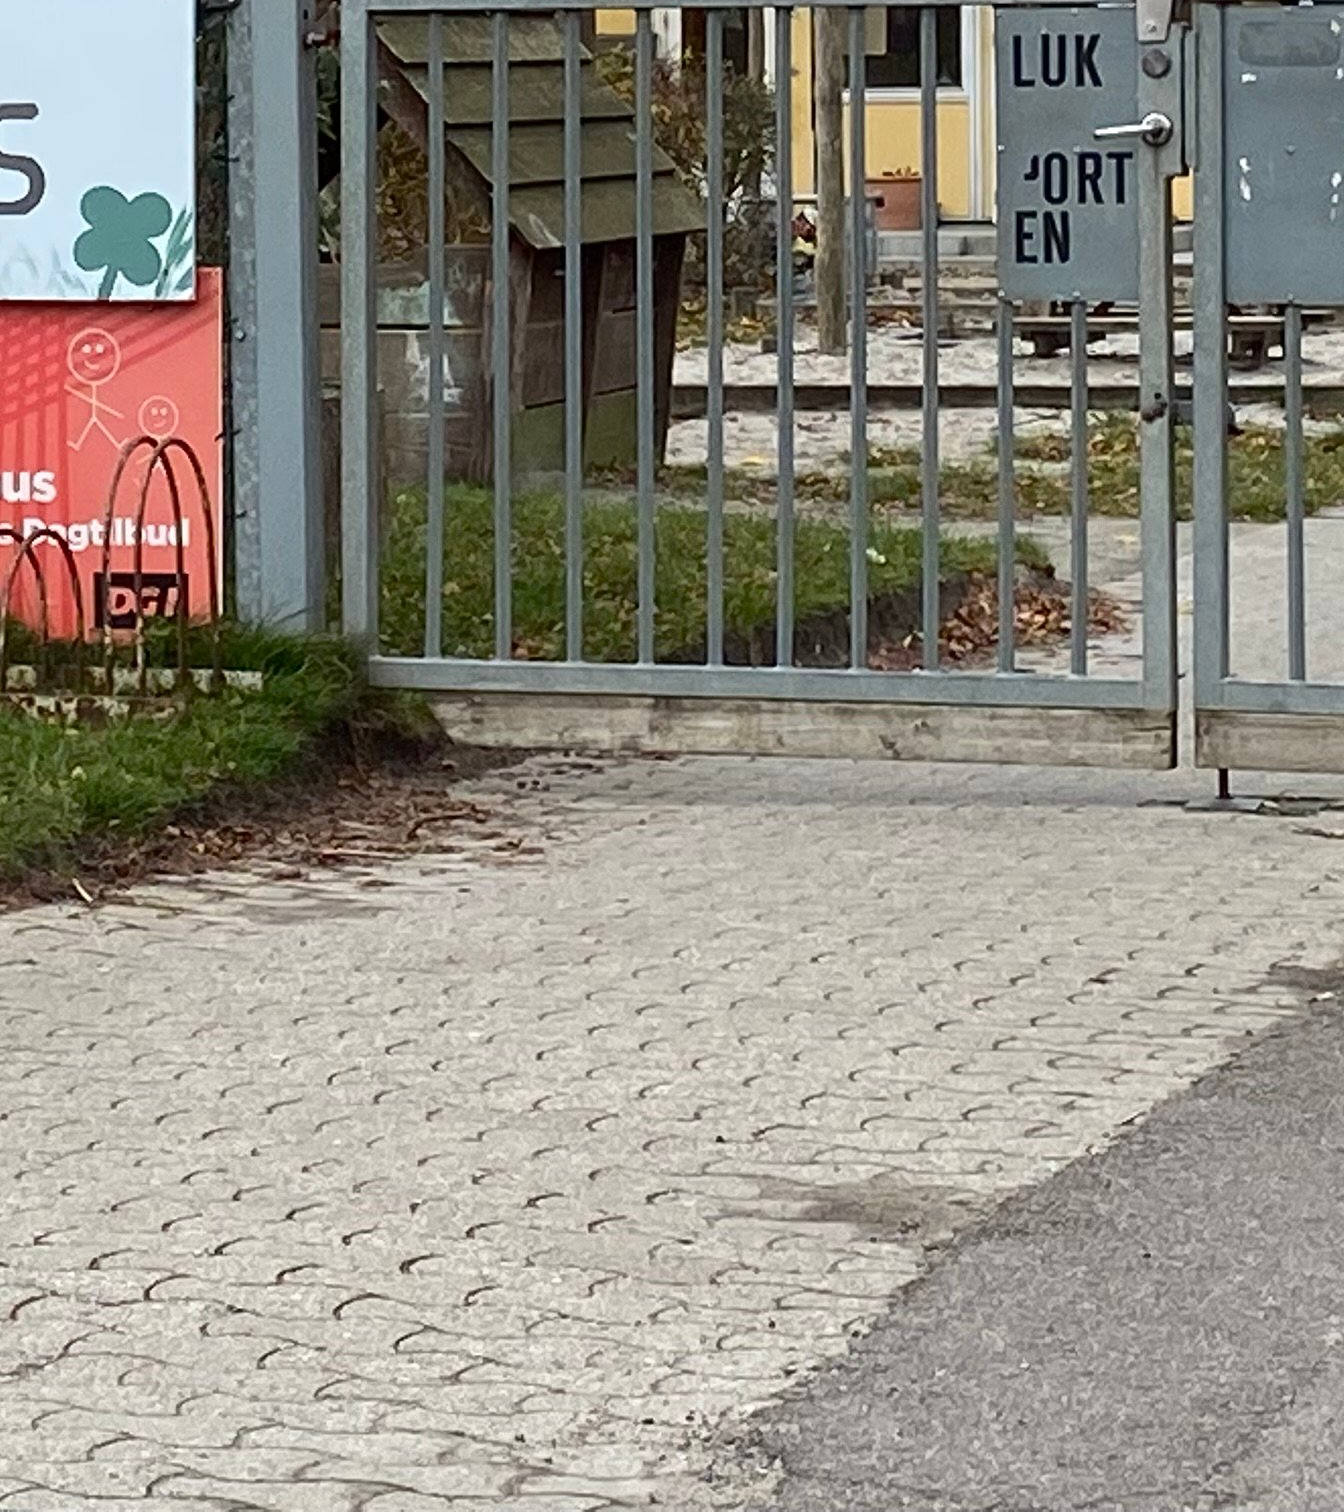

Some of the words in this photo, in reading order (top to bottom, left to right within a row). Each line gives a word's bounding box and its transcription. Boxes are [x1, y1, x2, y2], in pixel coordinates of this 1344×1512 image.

[1012, 33, 1103, 88] LUK
[1015, 210, 1071, 265] EN
[108, 586, 180, 618] DGI
